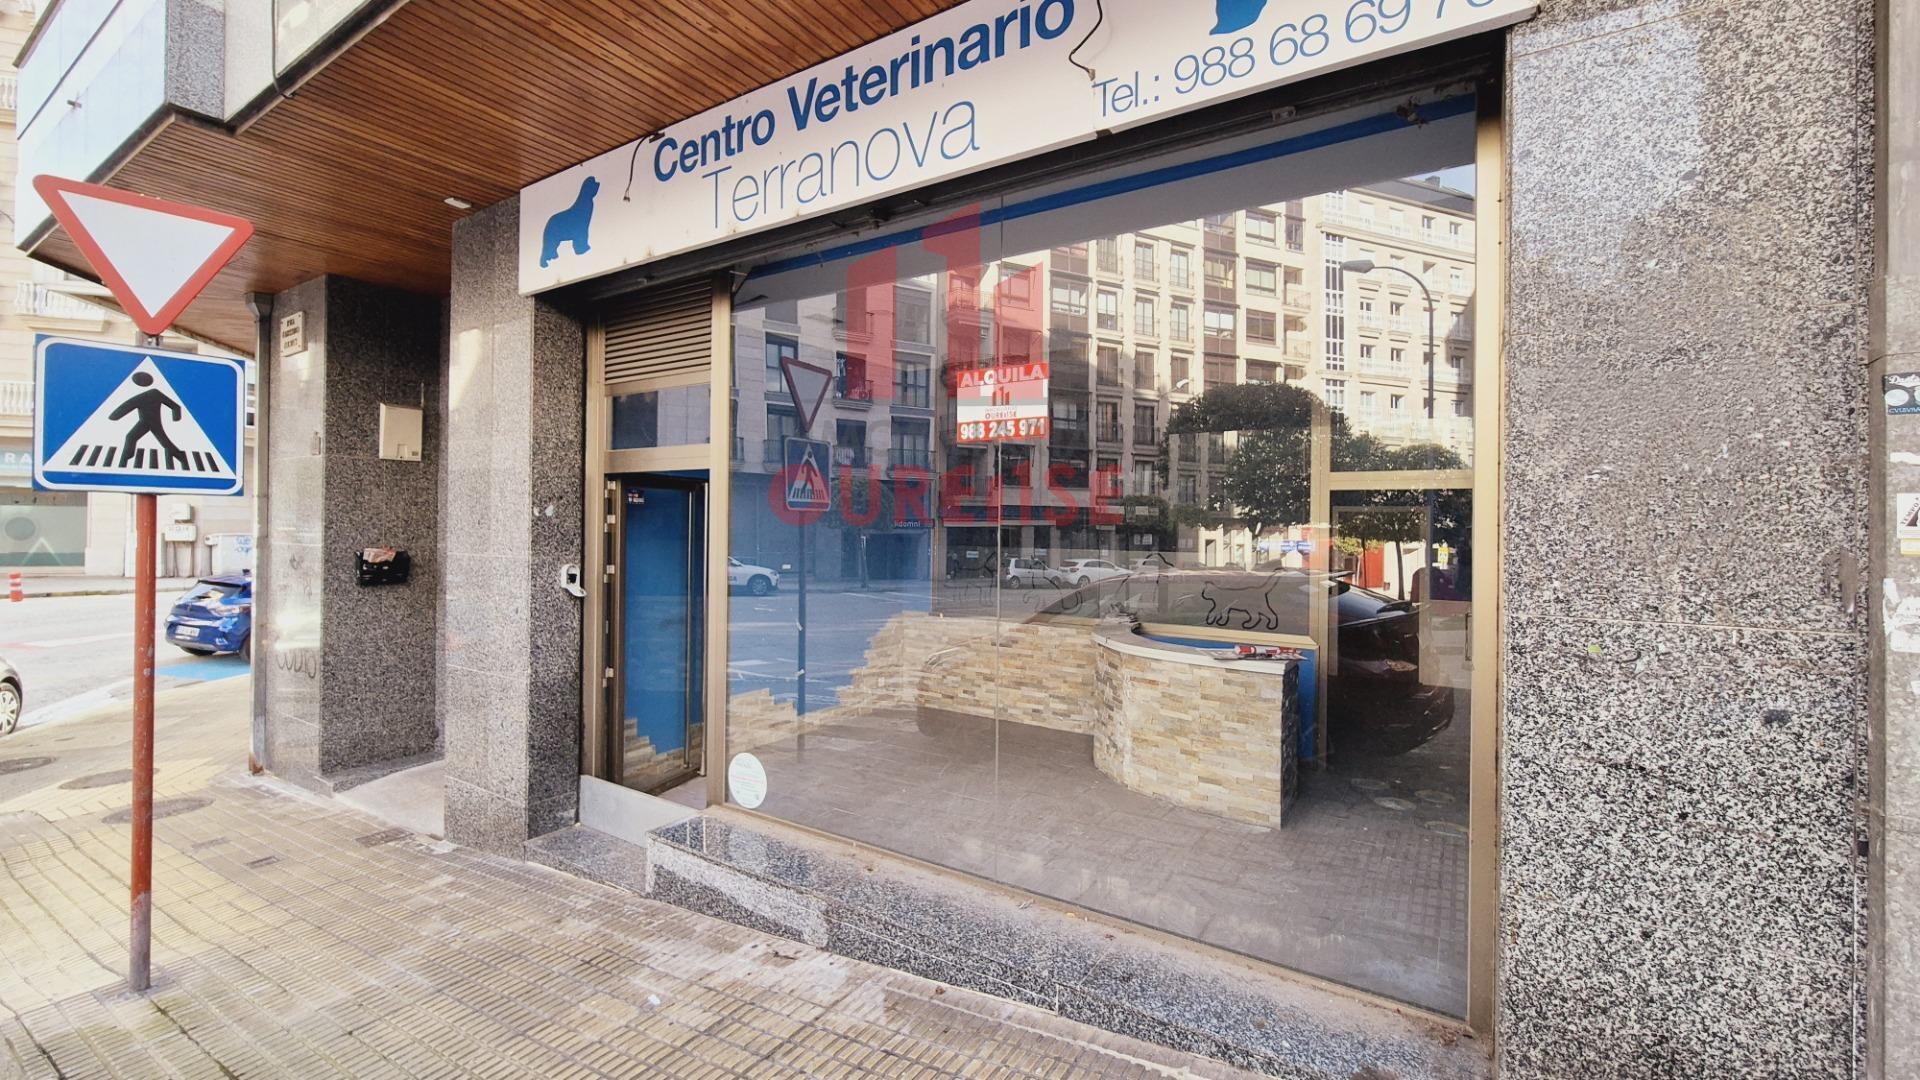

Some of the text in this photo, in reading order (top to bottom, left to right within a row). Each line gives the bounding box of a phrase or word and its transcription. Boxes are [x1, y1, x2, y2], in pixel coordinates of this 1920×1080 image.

[653, 0, 1074, 182] Centro Veterinario
[1091, 0, 1411, 117] Tel.: 988 68 69
[701, 100, 980, 229] Terranova
[960, 364, 1045, 388] ALQUILA
[960, 417, 1045, 440] 988 245 971
